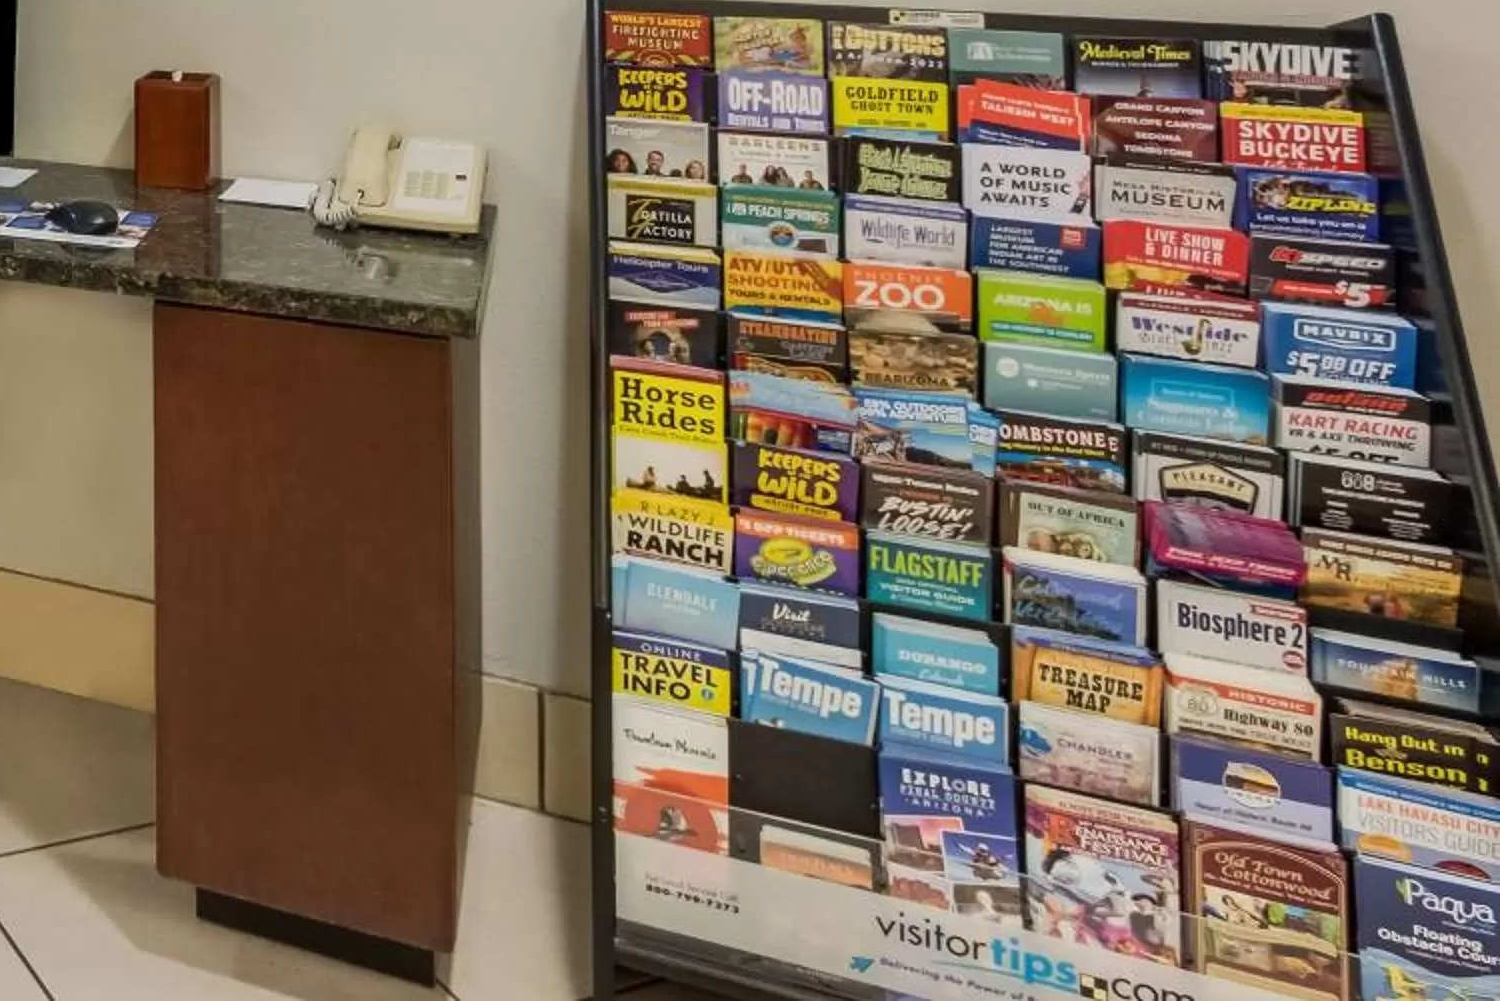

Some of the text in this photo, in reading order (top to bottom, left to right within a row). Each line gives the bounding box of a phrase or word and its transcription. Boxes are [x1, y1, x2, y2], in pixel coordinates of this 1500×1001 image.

[611, 15, 702, 28] WORLD'S LARGEST
[612, 26, 700, 40] FIREFIGHTING
[627, 37, 683, 50] MUSEUM
[1080, 41, 1191, 61] Medieval Times
[1225, 41, 1353, 79] SKYDIVE
[619, 69, 688, 89] KEEPERS
[729, 79, 823, 115] OFF-ROAD
[845, 87, 939, 102] GOLDFIELD
[851, 100, 933, 115] GHOST TOWN
[1114, 102, 1205, 115] GRAND CANYON
[1105, 115, 1214, 131] ANTELOPE CANYON
[1239, 121, 1357, 145] SKYDIVE
[1135, 132, 1181, 143] SEDONA
[1124, 144, 1192, 158] TOMBSTONE
[1240, 141, 1358, 164] BUCKEYE
[981, 162, 1066, 180] A WORLD
[980, 177, 1072, 195] OF MUSIC
[628, 199, 692, 224] TORTILLA
[980, 193, 1050, 208] AWAITS
[1111, 189, 1225, 212] MUSEUM
[749, 204, 829, 224] PEACH SPRINGS
[628, 222, 692, 240] FACTORY
[861, 218, 955, 248] Wildlife World
[1145, 227, 1225, 250] LIVE SHOW
[1011, 243, 1064, 256] AMERICAN
[1162, 245, 1224, 266] DINNER
[613, 255, 709, 273] Helicopter Tours
[1009, 258, 1070, 273] SOUTHWEST
[728, 275, 822, 292] SHOOTING
[853, 270, 945, 284] PHOENIX
[729, 290, 765, 300] TOURS
[854, 280, 945, 310] ZOO
[1348, 359, 1396, 379] OFF
[620, 377, 716, 410] Horse
[620, 401, 716, 435] Rides
[1288, 412, 1417, 440] KART RACING
[1000, 424, 1106, 448] OMBSTONE
[1348, 435, 1417, 451] THROWING
[759, 448, 840, 482] KEEPERS
[1172, 472, 1245, 492] PLEASANT
[878, 496, 974, 522] BUSTIN'
[1028, 502, 1125, 528] OUT OF AFRICA
[627, 513, 724, 547] WILDLIFE
[877, 512, 971, 542] LOOSE!
[627, 531, 723, 566] RANCH
[870, 546, 984, 587] FLAGSTAFF
[773, 602, 810, 622] Visit
[1177, 602, 1304, 649] Biosphere 2
[640, 642, 700, 661] ONLINE
[898, 649, 987, 675] DURANGO
[620, 653, 718, 687] TRAVEL
[1039, 663, 1143, 701] TREASURE
[1421, 674, 1466, 689] HILLS
[623, 672, 691, 700] INFO
[758, 654, 863, 719] Tempe
[1066, 690, 1111, 714] MAP
[1228, 691, 1308, 712] HISTORIC
[884, 688, 995, 747] Tempe
[1223, 708, 1314, 737] Highway 80
[1057, 738, 1133, 760] CHANDLER
[1345, 727, 1465, 756] Hang Out in
[1346, 748, 1467, 784] Benson
[901, 768, 992, 798] EXPLORE
[911, 798, 985, 818] ARIZONA
[1358, 794, 1395, 814] LAKE
[1401, 805, 1463, 832] HAVASU
[1467, 818, 1500, 836] CITY
[1046, 813, 1168, 857] RENAISSANCE
[1359, 810, 1500, 856] VISITORS GUIDE
[1081, 835, 1168, 868] FESTIVAL
[1215, 851, 1303, 882] Old Town
[1221, 867, 1333, 900] Cottonwood
[1377, 927, 1454, 956] Obstacle
[1458, 947, 1500, 966] Cour
[1413, 924, 1483, 952] Floating
[880, 957, 940, 982] Delivering
[967, 979, 1007, 996] Power
